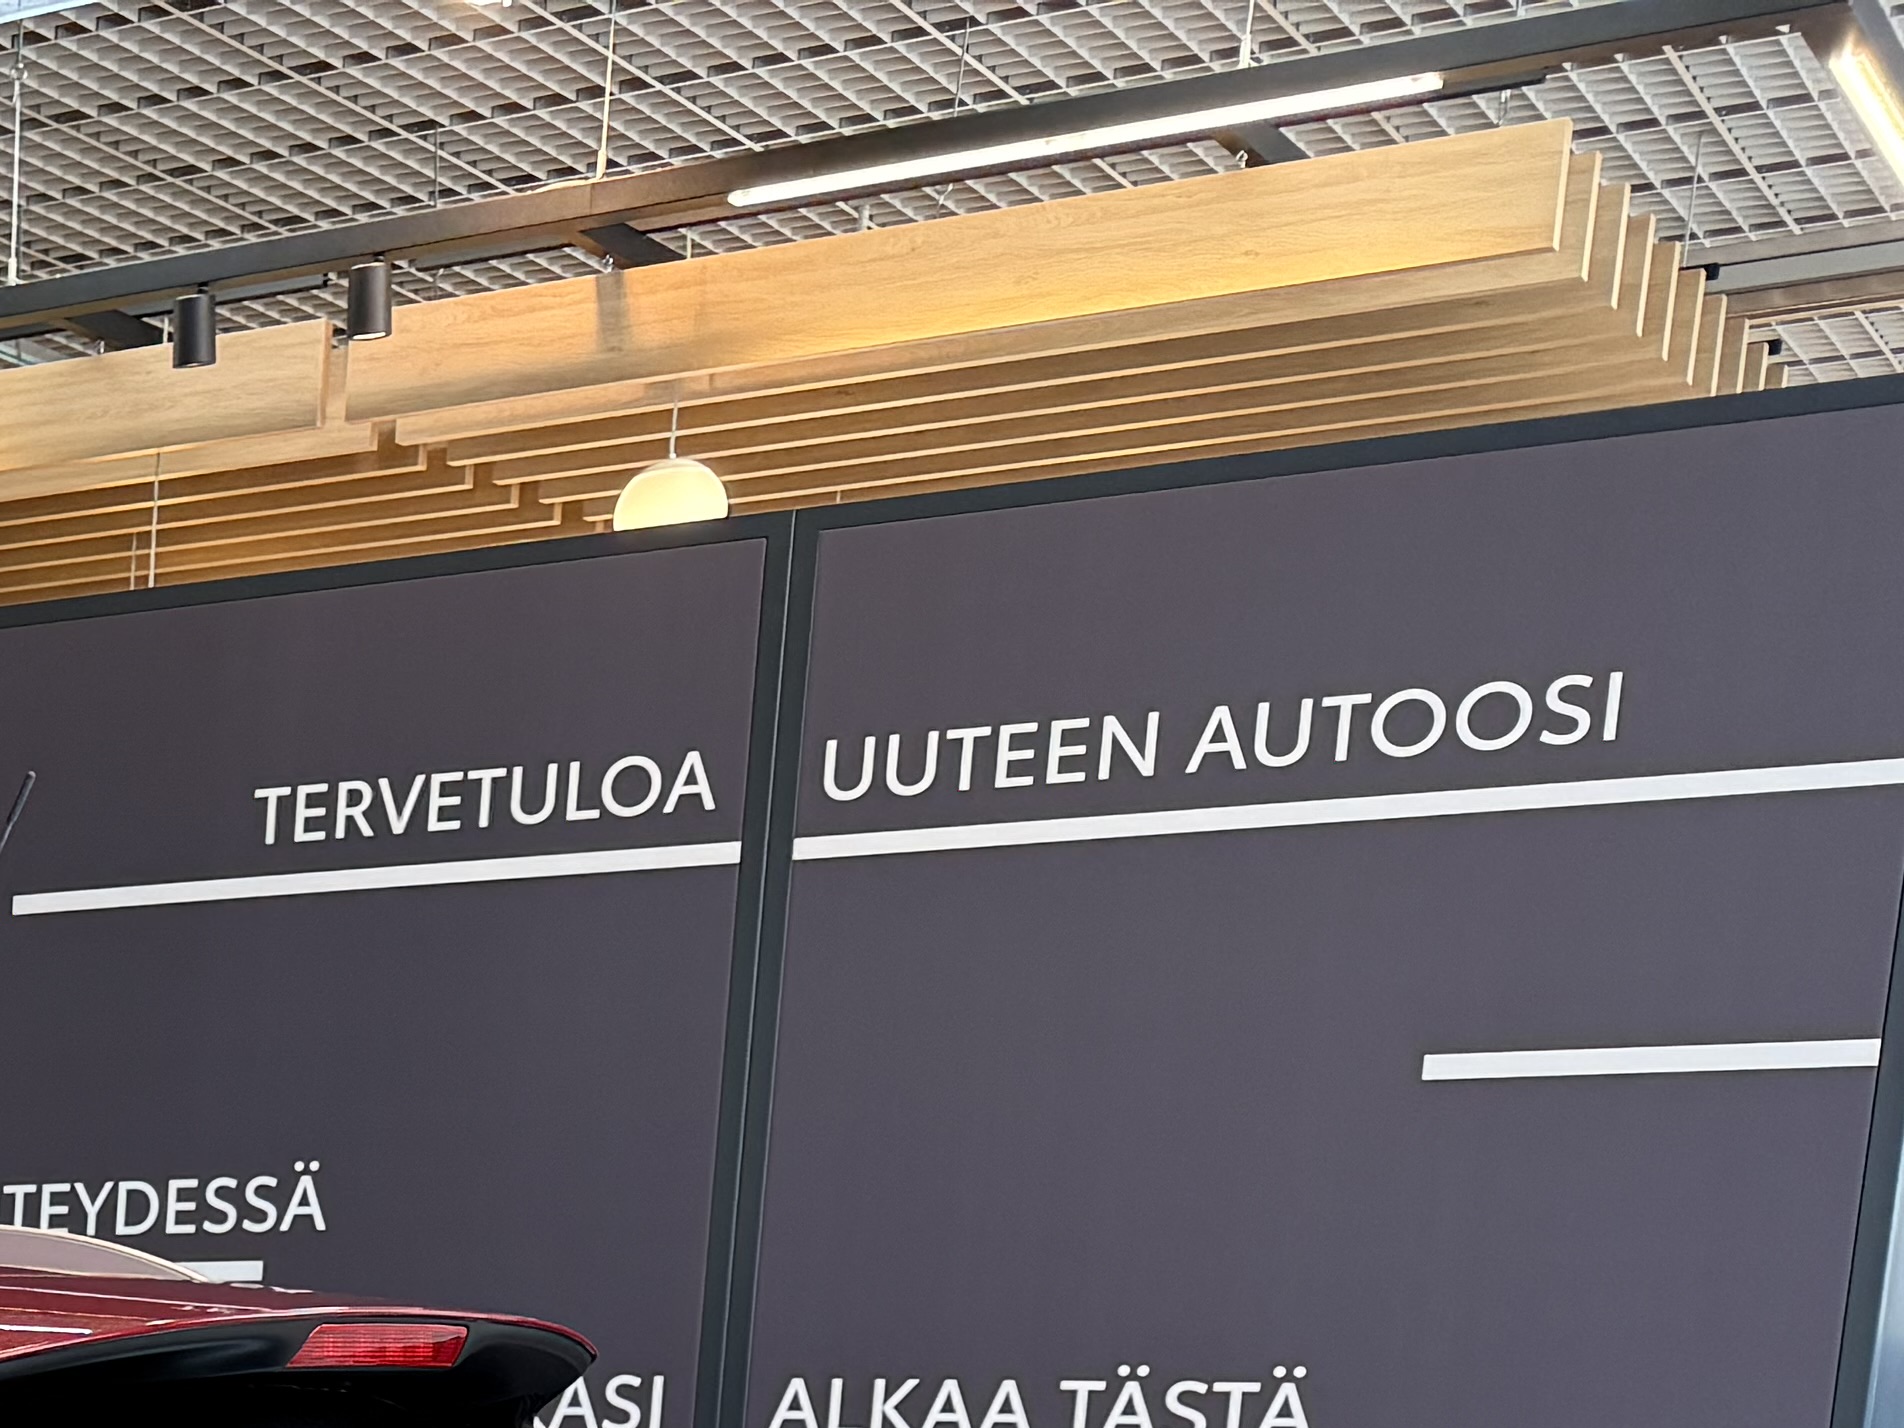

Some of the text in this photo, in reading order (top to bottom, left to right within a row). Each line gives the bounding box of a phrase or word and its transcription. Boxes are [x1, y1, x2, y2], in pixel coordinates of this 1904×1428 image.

[253, 670, 1625, 846] TERVETULOA UUTEEN AUTOOSI
